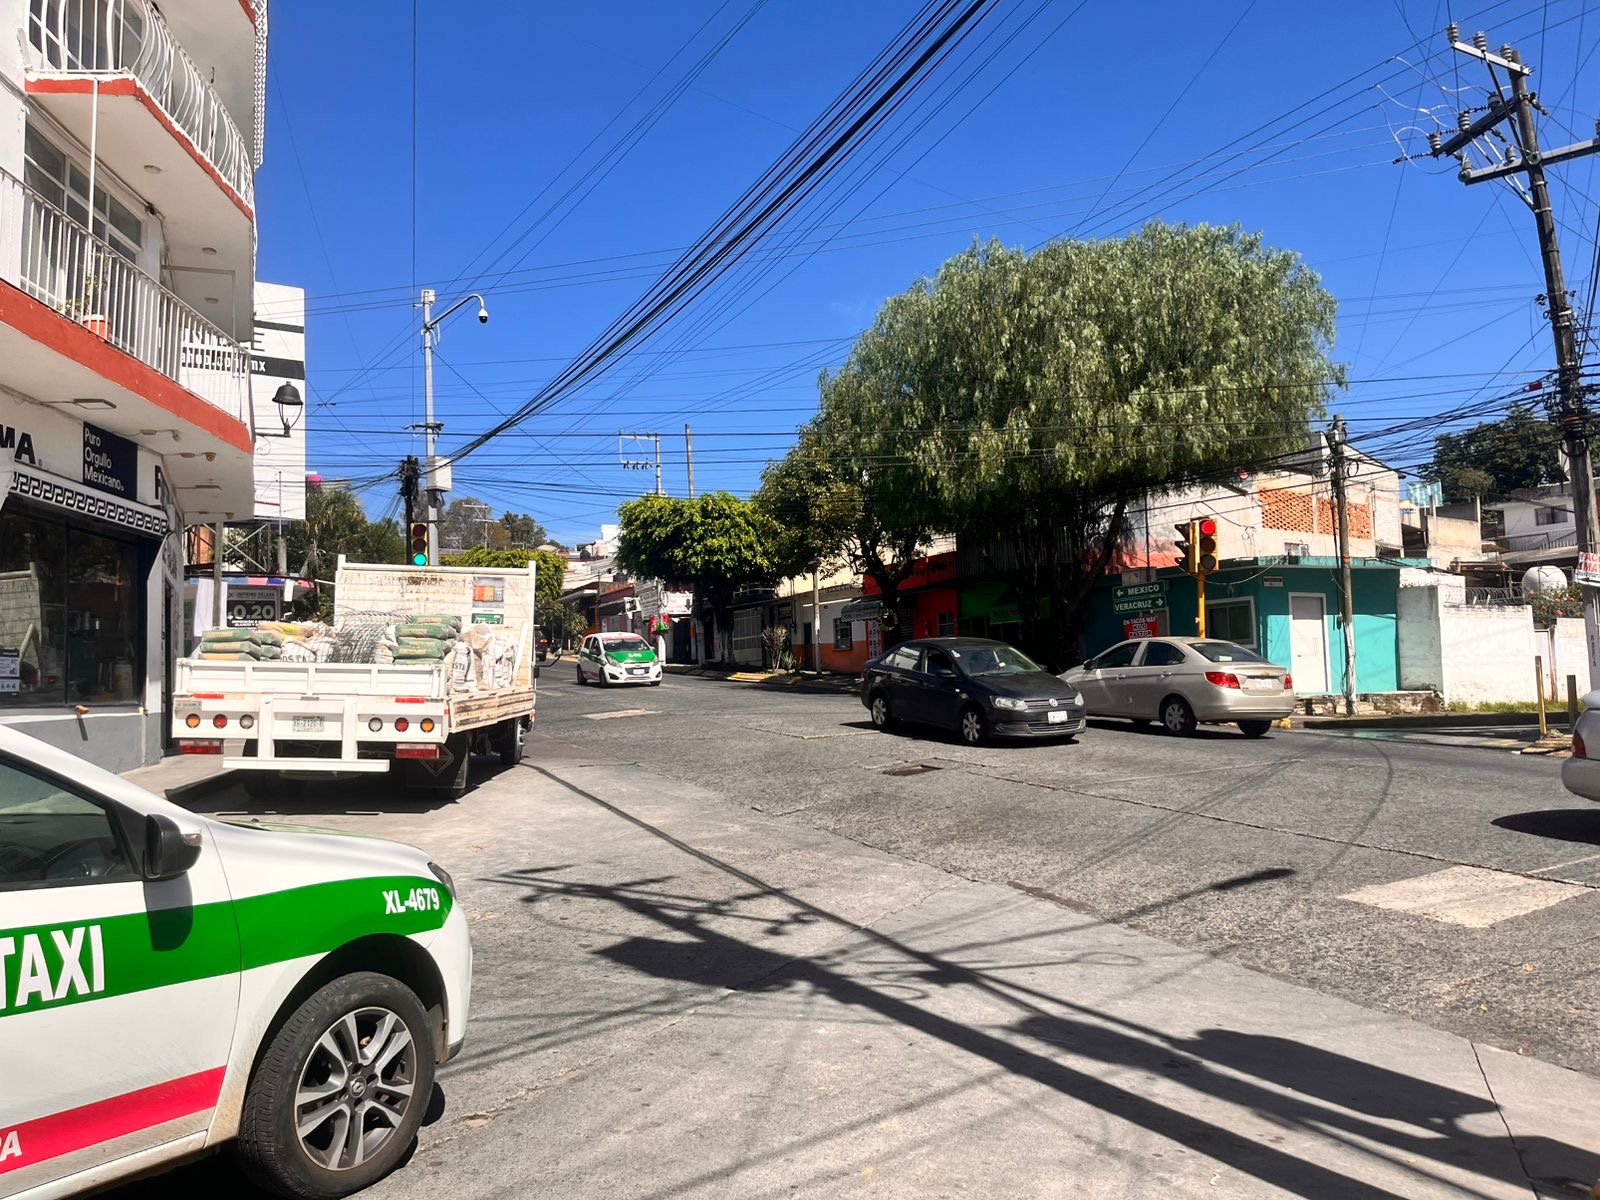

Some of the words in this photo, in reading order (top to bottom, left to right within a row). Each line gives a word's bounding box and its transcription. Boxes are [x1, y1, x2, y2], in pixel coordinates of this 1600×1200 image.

[84, 428, 101, 446] Puro
[84, 447, 112, 469] Orgullo
[1127, 585, 1160, 595] MEXICO
[1114, 600, 1153, 611] VERACRUZ
[382, 887, 440, 915] XL-4679
[0, 924, 105, 1010] TAXI
